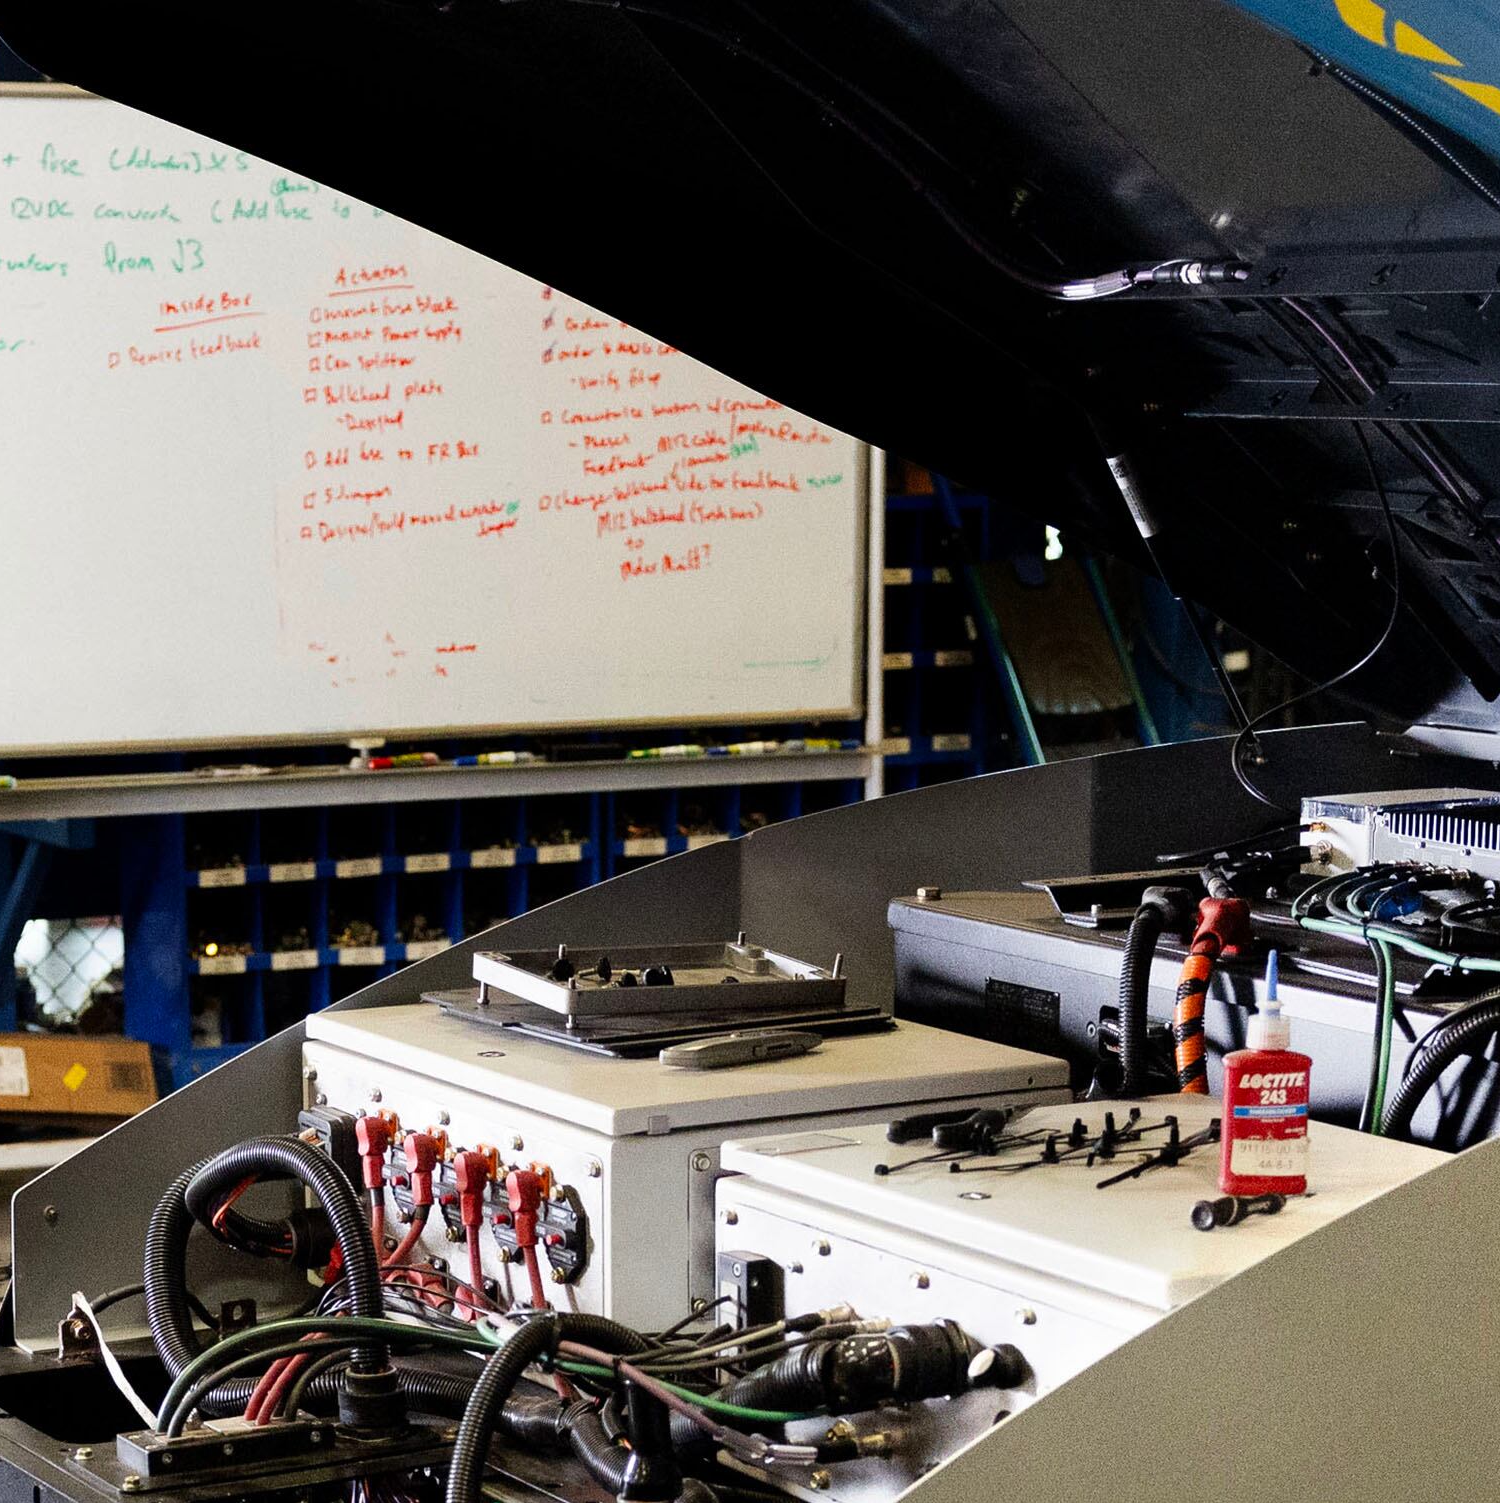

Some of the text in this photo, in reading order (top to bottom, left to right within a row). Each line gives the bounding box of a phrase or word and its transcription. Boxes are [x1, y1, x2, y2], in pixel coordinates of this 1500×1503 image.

[10, 197, 74, 220] 12VDC
[1239, 1072, 1306, 1089] LOCTITE
[1260, 1089, 1288, 1105] 243
